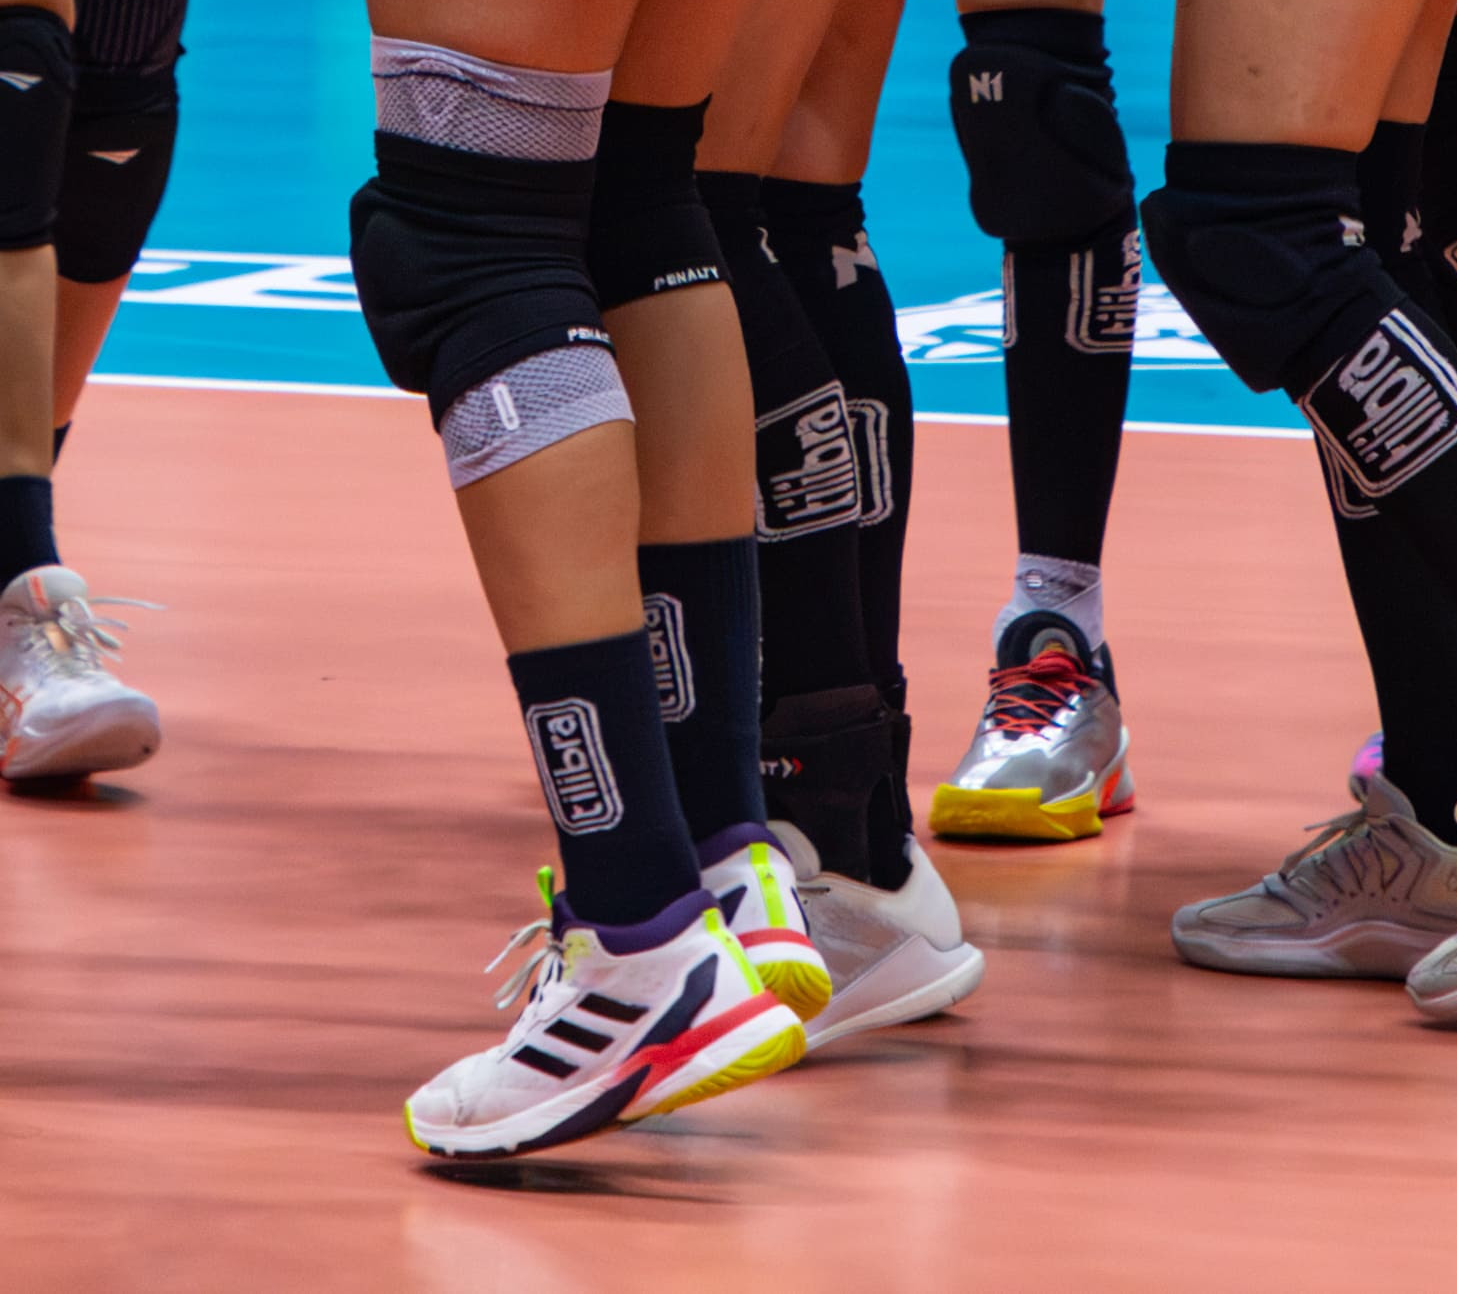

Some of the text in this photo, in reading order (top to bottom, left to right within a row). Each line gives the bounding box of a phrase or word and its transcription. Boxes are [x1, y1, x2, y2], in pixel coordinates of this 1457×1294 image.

[653, 265, 720, 291] PENALTY
[1338, 329, 1450, 473] tilibra
[769, 400, 857, 520] tilibra
[547, 713, 604, 822] tilibra
